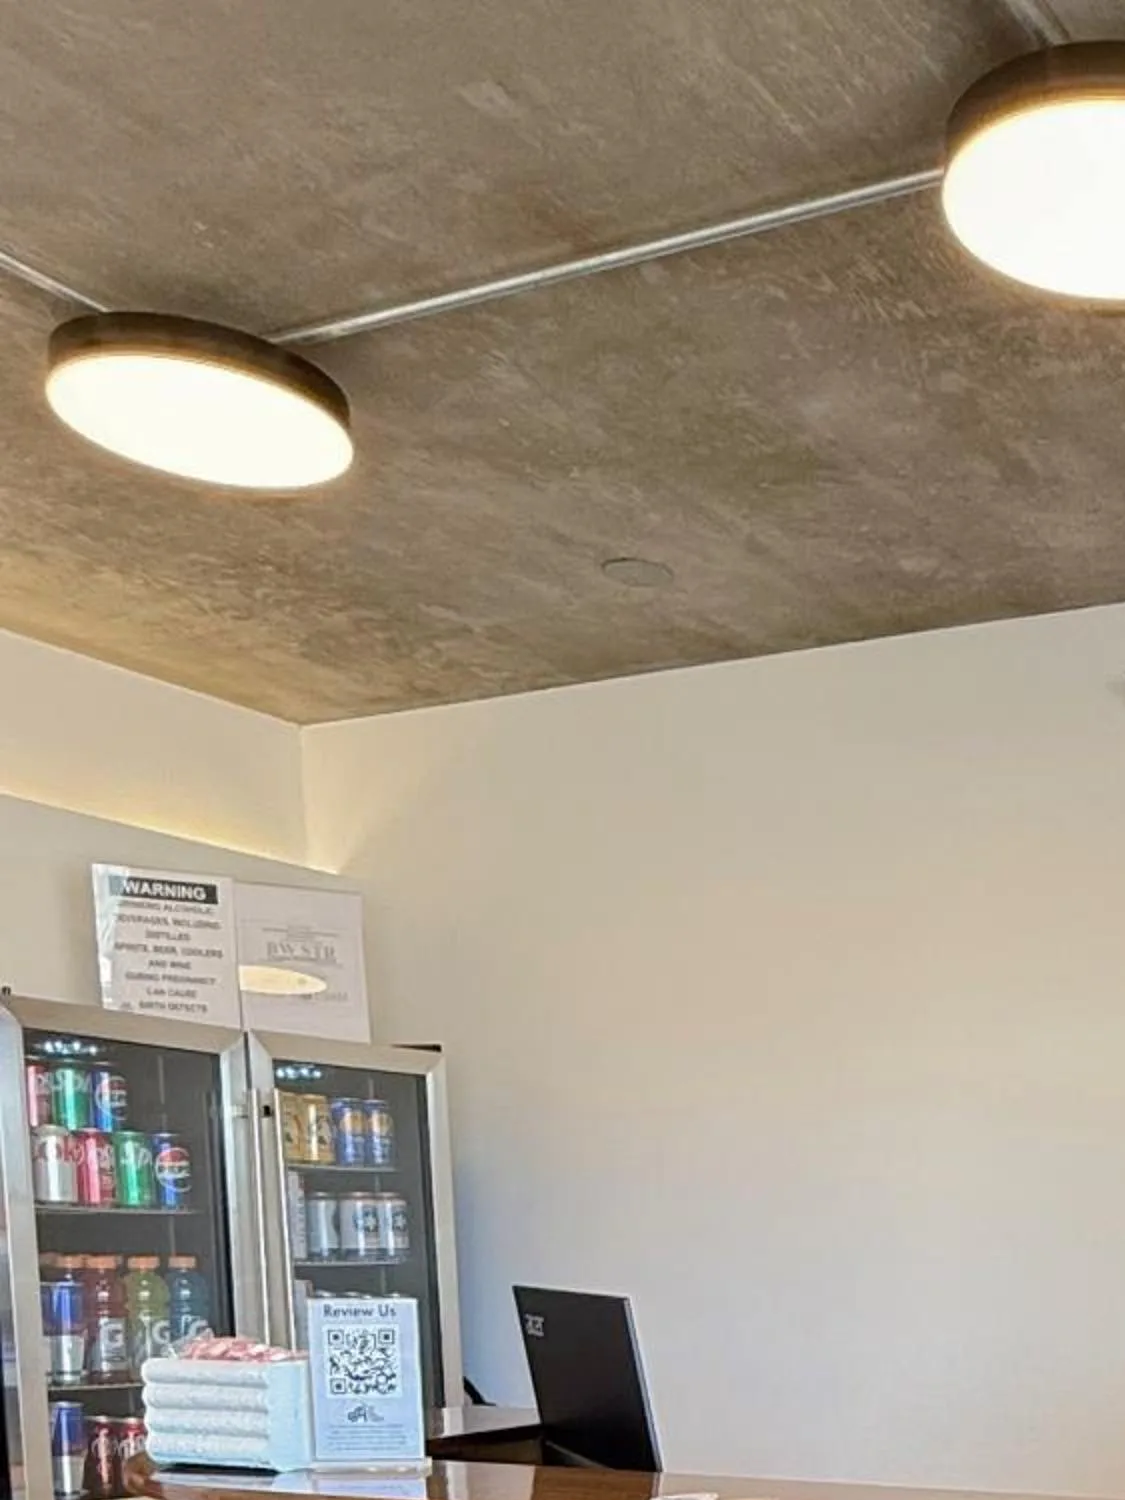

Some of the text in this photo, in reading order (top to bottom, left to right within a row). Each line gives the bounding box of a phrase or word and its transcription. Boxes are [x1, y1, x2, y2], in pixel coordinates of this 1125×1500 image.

[122, 880, 207, 900] WARNING
[148, 959, 167, 969] AND
[323, 1303, 397, 1317] Review Us
